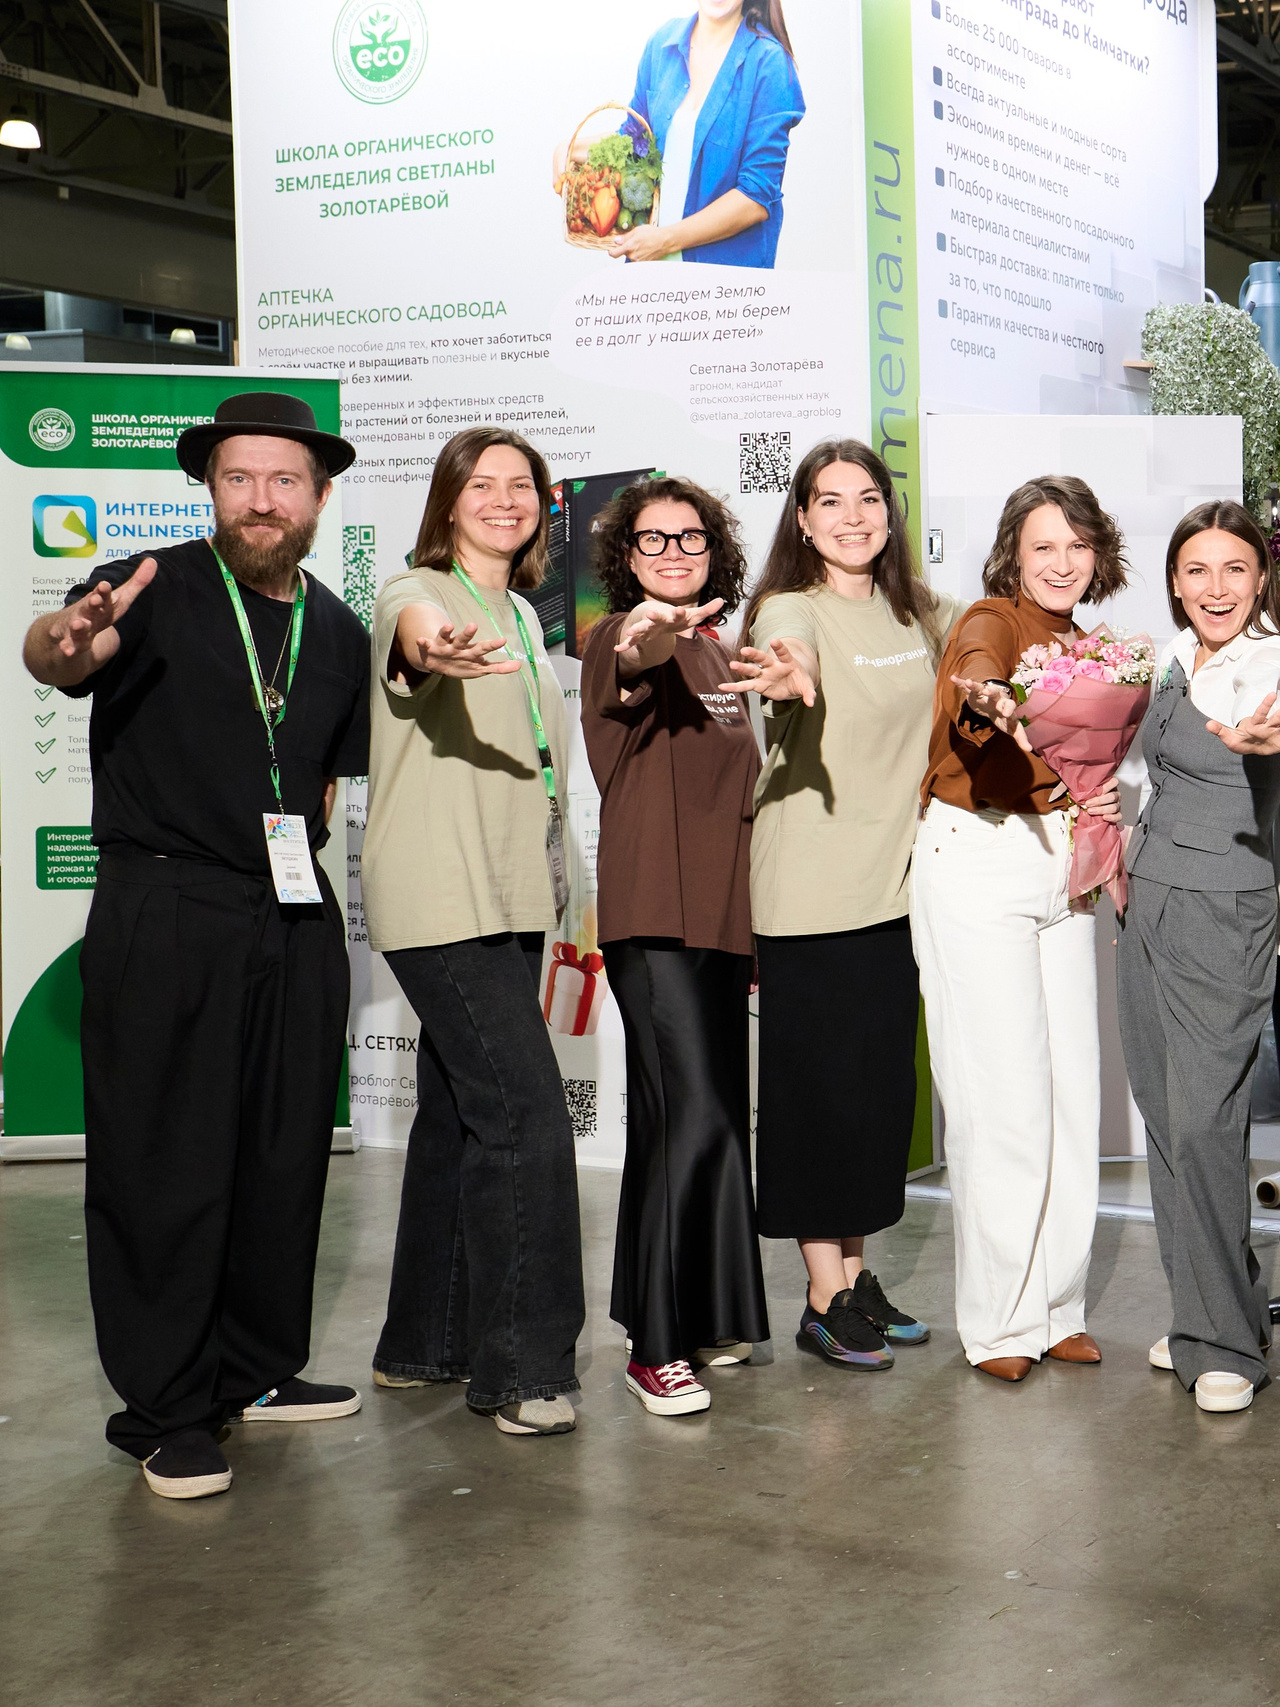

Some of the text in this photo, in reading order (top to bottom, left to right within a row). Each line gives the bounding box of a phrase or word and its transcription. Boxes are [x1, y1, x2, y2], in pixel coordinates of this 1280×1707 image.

[945, 5, 1072, 80] Более 25 000 товаров в
[1063, 19, 1079, 40] до
[1084, 24, 1150, 76] Камчатки?
[356, 45, 405, 70] eco
[946, 43, 1026, 90] ассортименте
[947, 72, 1127, 163] Всегда актуальные и модные сорта
[276, 128, 495, 164] ШКОЛА ОРГАНИЧЕСКОГО
[948, 105, 1005, 143] Экономия
[1008, 133, 1053, 163] времени
[1055, 155, 1062, 166] и
[1064, 156, 1092, 178] денег
[1104, 172, 1120, 188] всё
[275, 158, 495, 193] ЗЕМЛЕДЕЛИЯ СВЕТЛАНЫ
[946, 141, 1069, 198] нужное в одном месте
[319, 189, 450, 218] ЗОЛОТАРЁВОЙ
[949, 170, 1135, 250] Подбор качественного посадочного
[950, 208, 1091, 264] материала специалистами
[950, 236, 1125, 303] Быстрая доставка: платите только
[257, 288, 334, 307] АПТЕЧКА
[575, 285, 766, 308] «Мы не наследуем Землю
[949, 272, 1052, 312] за то, что подошло
[258, 300, 508, 330] ОРГАНИЧЕСКОГО САДОВОДА
[575, 303, 791, 328] от наших предков, мы берем
[575, 325, 763, 348] ее в долг у наших детей»
[951, 301, 1105, 356] Гарантия качества и честного
[258, 332, 552, 359] Методическое пособие для тех, кто хочет заботиться
[950, 337, 996, 360] сервиса
[349, 358, 356, 369] и
[359, 355, 429, 370] выращивать
[431, 351, 487, 365] полезные
[490, 352, 498, 362] и
[500, 348, 550, 362] вкусные
[689, 358, 824, 376] Светлана Золотарёва
[351, 373, 371, 385] без
[373, 372, 413, 384] химии.
[689, 378, 783, 395] агроном, кандидат
[408, 399, 415, 410] и
[417, 396, 496, 410] эффективных
[498, 393, 545, 406] средств
[689, 389, 830, 406] сельскохозяйственных наук
[91, 414, 138, 424] ШКОЛА
[355, 415, 408, 430] растений
[411, 415, 423, 425] от
[426, 411, 481, 424] болезней
[485, 411, 492, 422] и
[495, 408, 569, 425] вредителей,
[689, 406, 842, 424] @svetlana_zolotareva_agroblog
[91, 426, 174, 437] ЗЕМЛЕДЕЛИЯ
[429, 431, 435, 441] в
[523, 424, 595, 437] земледелии
[349, 459, 386, 470] езных
[544, 450, 592, 466] помогут
[353, 475, 366, 485] со
[106, 549, 131, 559] для
[32, 577, 63, 585] Более
[65, 577, 77, 585] 25
[47, 865, 84, 874] урожая
[365, 1035, 417, 1052] СЕТЯХ
